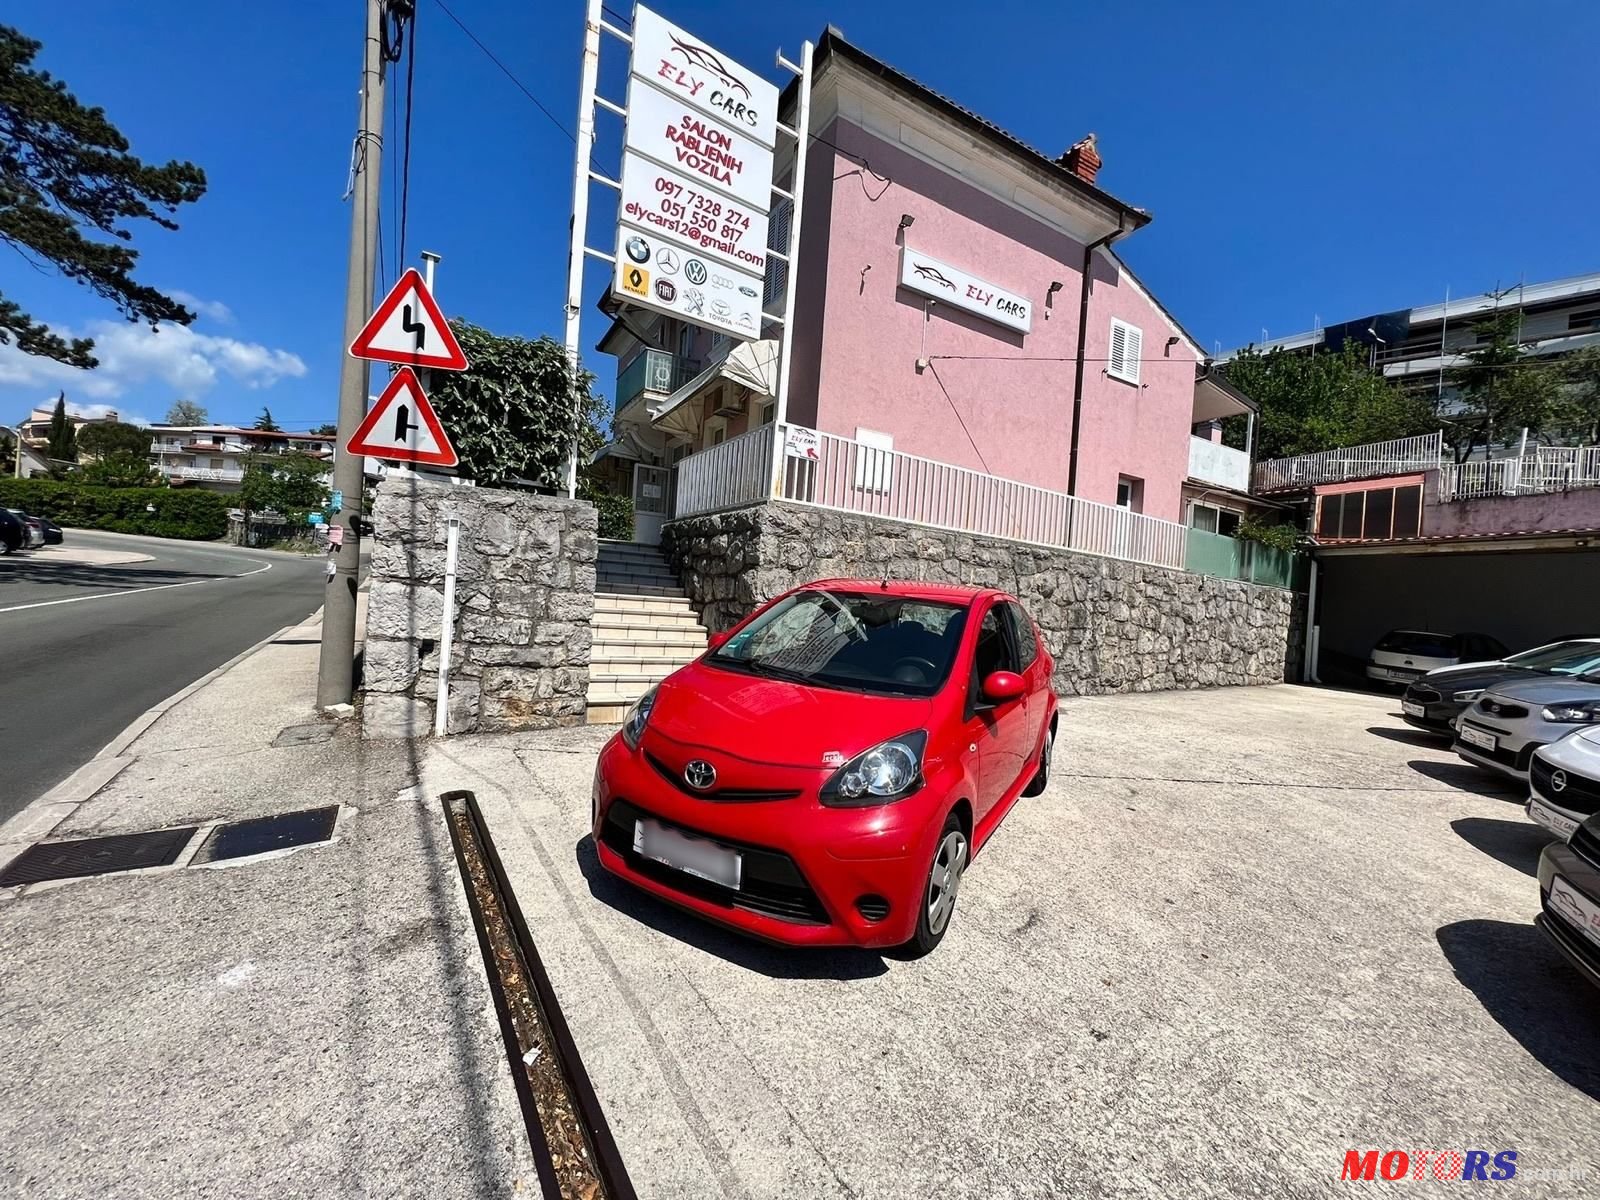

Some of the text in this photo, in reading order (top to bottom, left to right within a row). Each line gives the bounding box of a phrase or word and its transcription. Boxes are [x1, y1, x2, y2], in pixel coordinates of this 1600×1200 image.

[657, 59, 758, 127] ELY CARS
[665, 124, 743, 174] RABLJENIH
[680, 115, 732, 151] SALON
[675, 146, 732, 186] VOZILA
[655, 177, 750, 230] 097 7328 274
[661, 199, 743, 243] 051 550 817
[625, 202, 764, 267] elycars12@gmail.com
[658, 281, 673, 299] FIAT
[966, 284, 1026, 319] ELY CARS
[708, 312, 733, 326] TOYOTA
